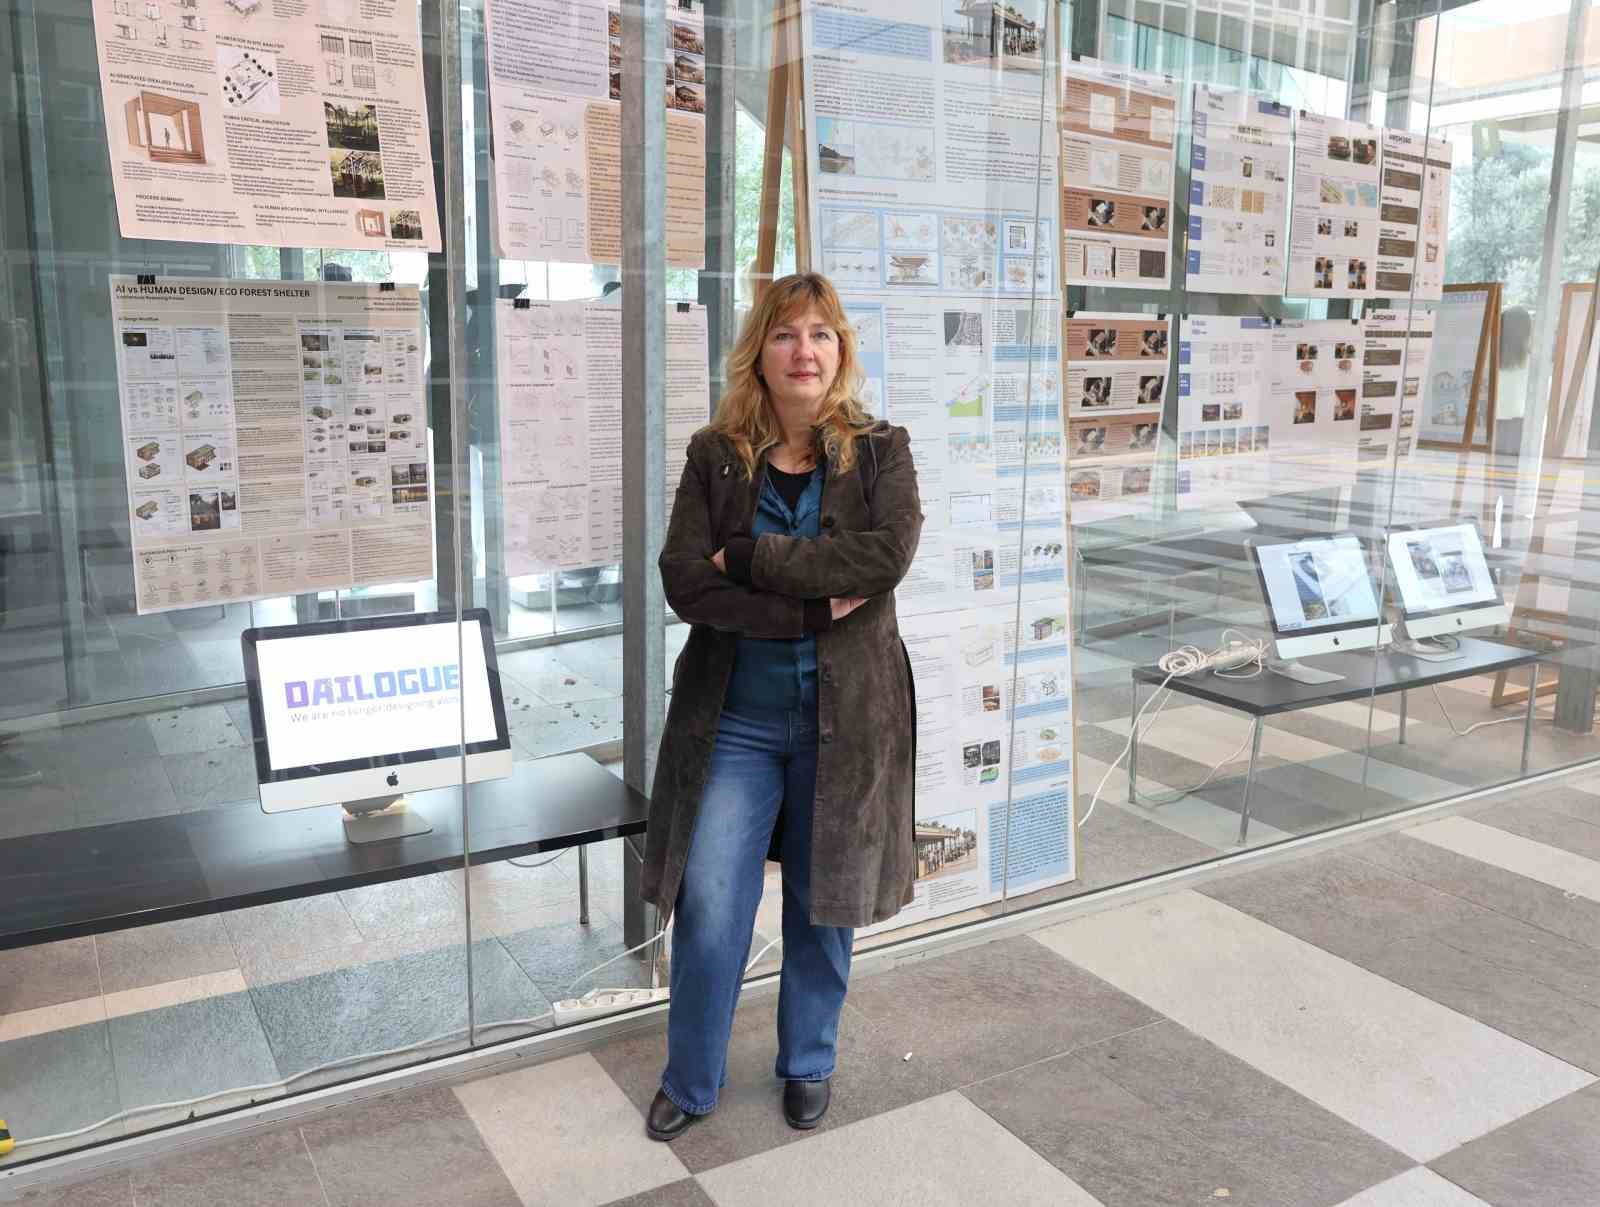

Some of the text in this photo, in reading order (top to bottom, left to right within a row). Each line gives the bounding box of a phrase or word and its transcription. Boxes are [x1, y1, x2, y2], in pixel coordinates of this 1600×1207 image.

[115, 284, 125, 294] AI
[139, 285, 177, 295] HUMAN
[219, 287, 238, 297] ECO
[239, 287, 272, 297] FOREST
[273, 288, 311, 298] SHELTER
[285, 664, 459, 709] DAILOGUE
[290, 712, 309, 723] We
